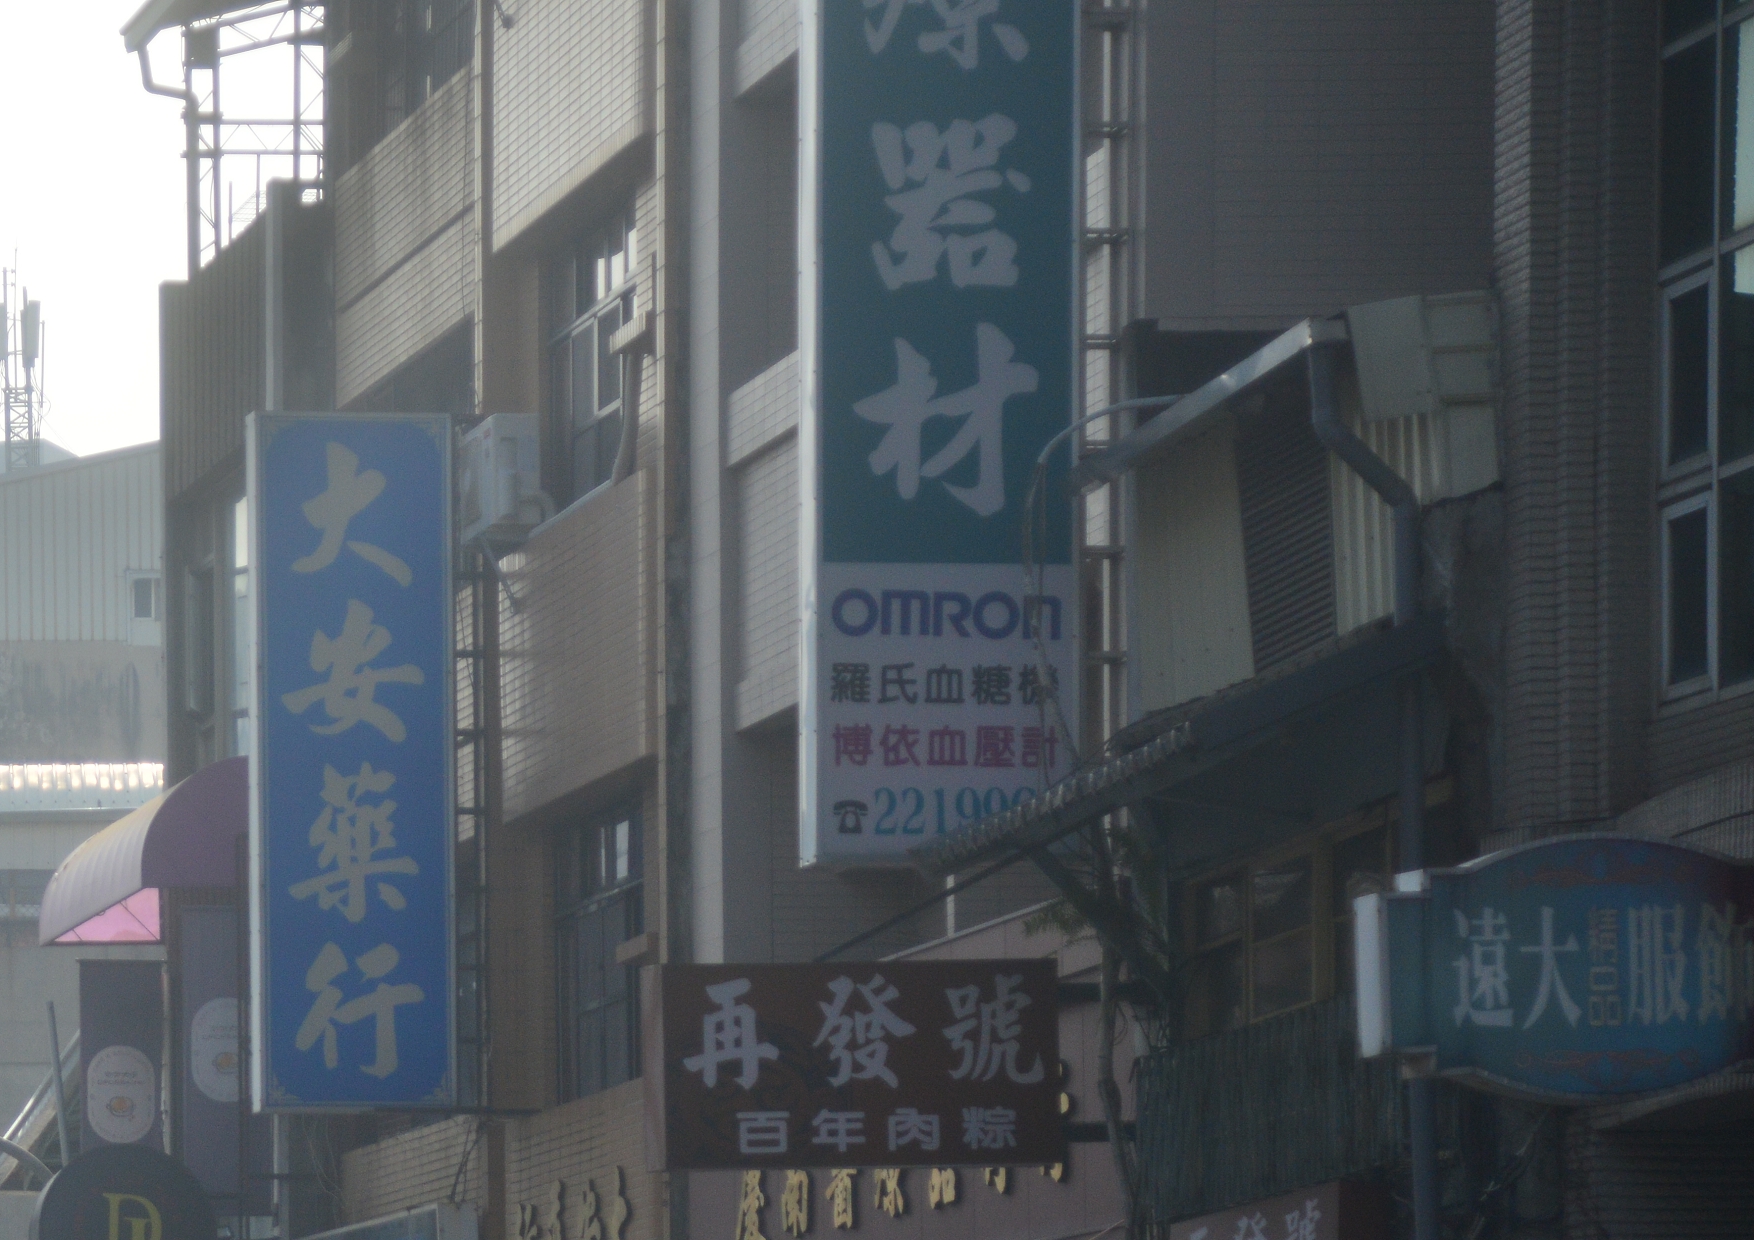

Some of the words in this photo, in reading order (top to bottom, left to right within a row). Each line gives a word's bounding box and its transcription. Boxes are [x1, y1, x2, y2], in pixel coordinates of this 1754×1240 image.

[831, 587, 1062, 640] OMRON
[282, 441, 425, 1079] 大安藥行
[832, 723, 1059, 768] 博依血壓計
[684, 972, 1044, 1089] 再發號
[736, 1105, 1018, 1155] 百年肉粽
